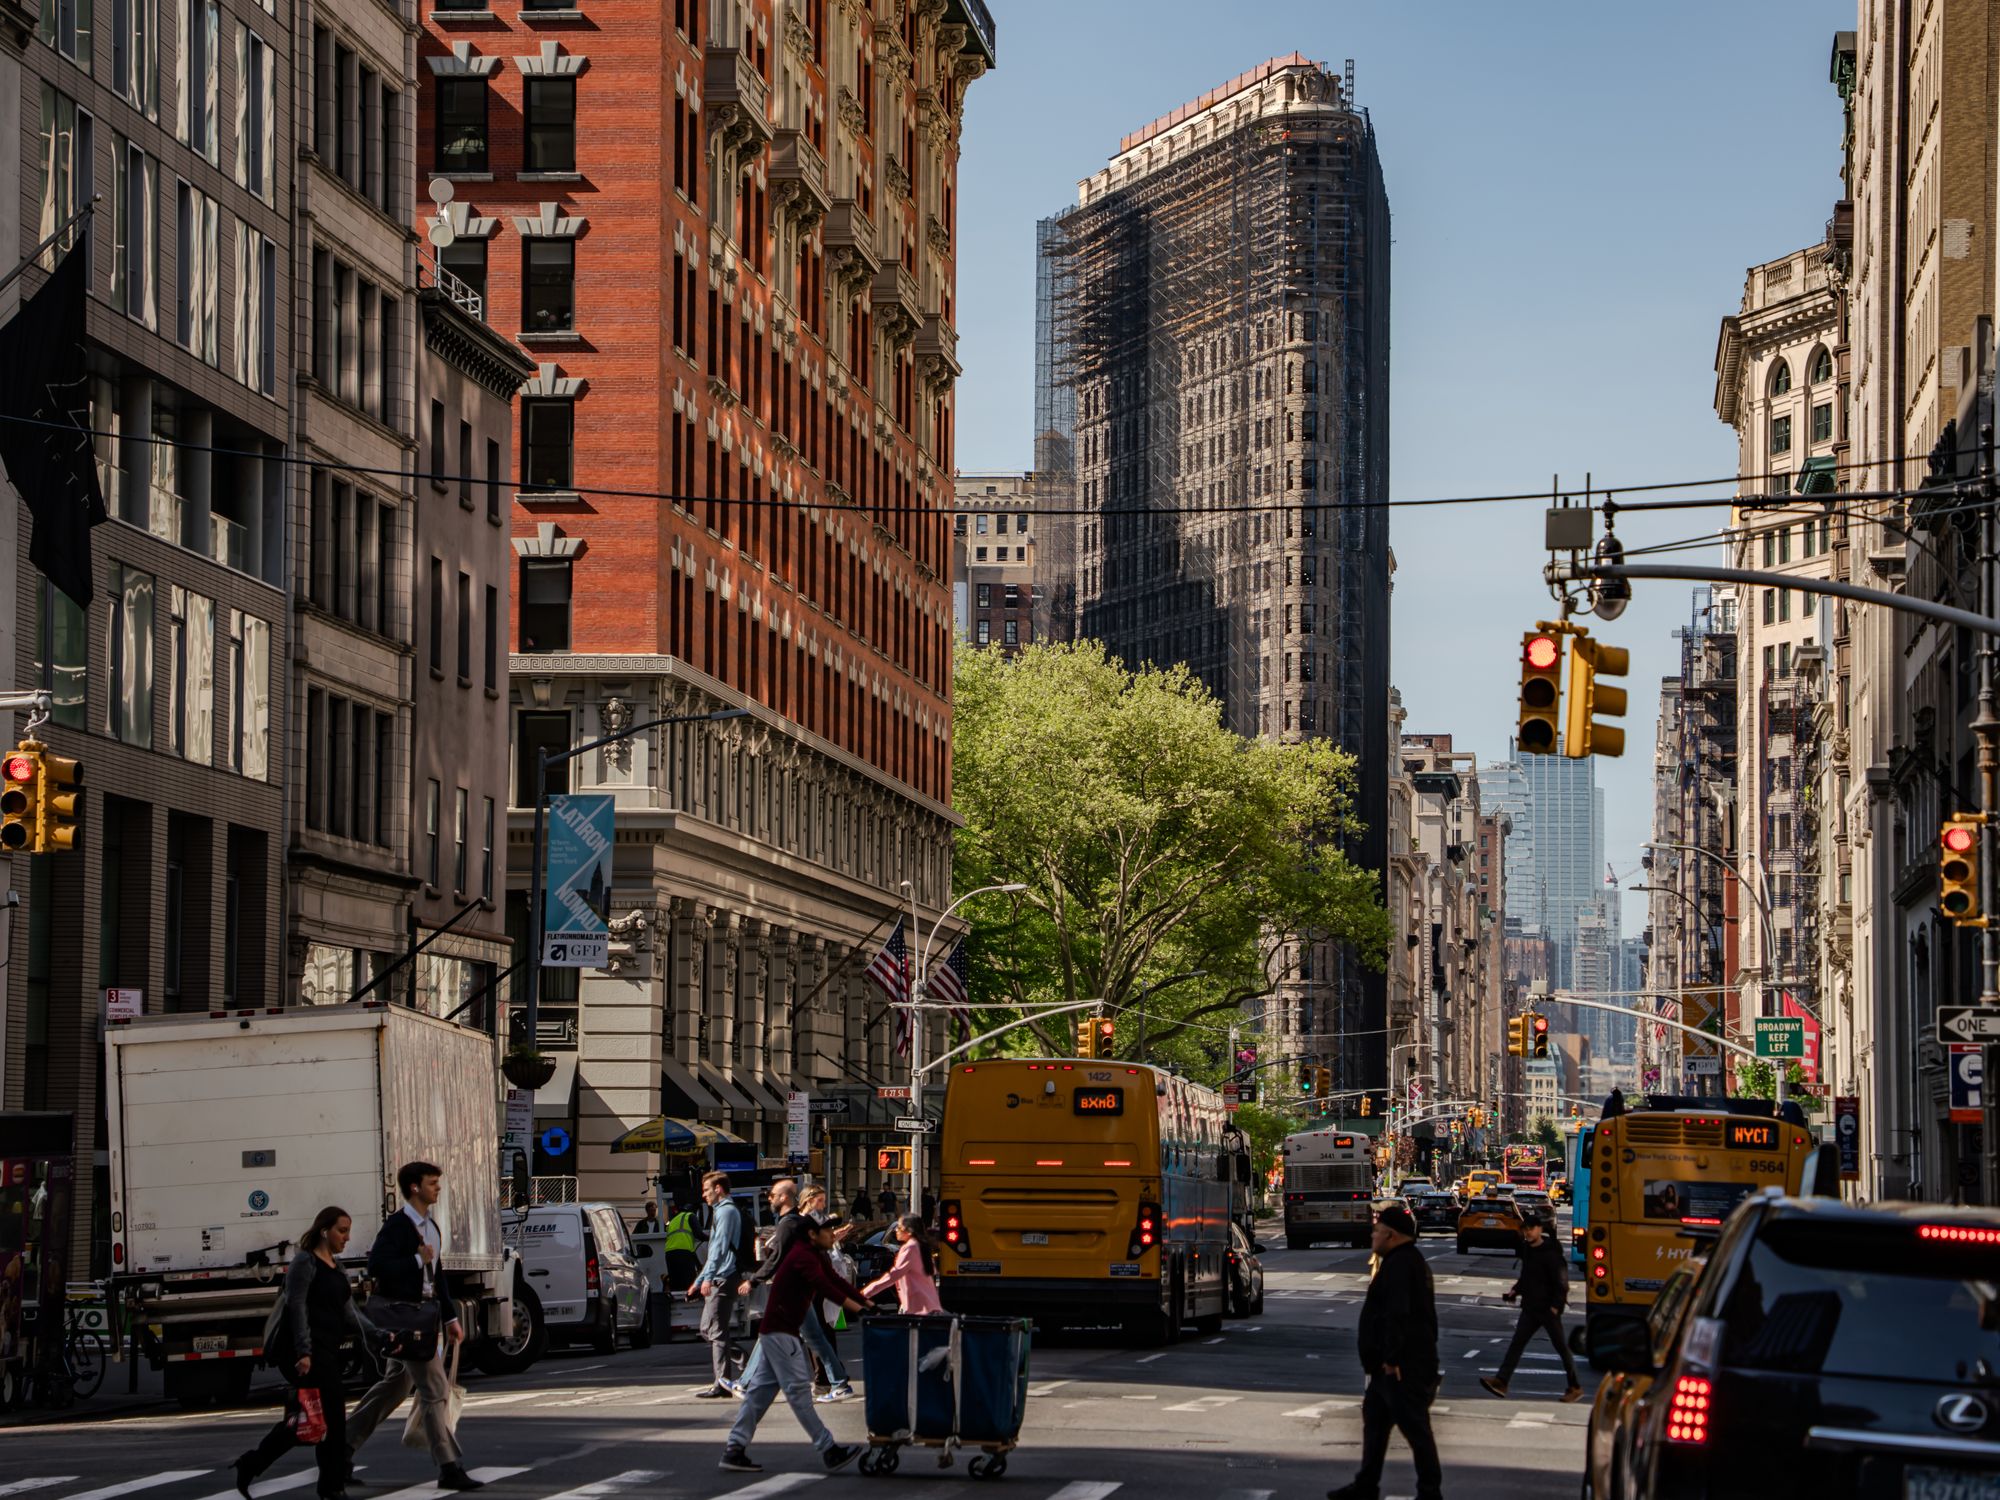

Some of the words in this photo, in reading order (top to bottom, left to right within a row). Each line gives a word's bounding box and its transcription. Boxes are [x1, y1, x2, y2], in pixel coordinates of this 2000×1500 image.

[551, 796, 610, 853] FLATIRON
[554, 885, 600, 931] NOMAD
[547, 933, 606, 941] FLATIRONNOMAD.NYC
[571, 944, 601, 957] GFP
[1757, 1023, 1800, 1031] BROADWAY
[1957, 1018, 1987, 1032] ONE
[1768, 1033, 1790, 1042] KEEP
[1769, 1043, 1789, 1052] LEFT
[1088, 1072, 1112, 1081] 1422
[1734, 1127, 1768, 1144] NYCT
[1750, 1160, 1784, 1173] 9564
[512, 1224, 556, 1233] SREAM
